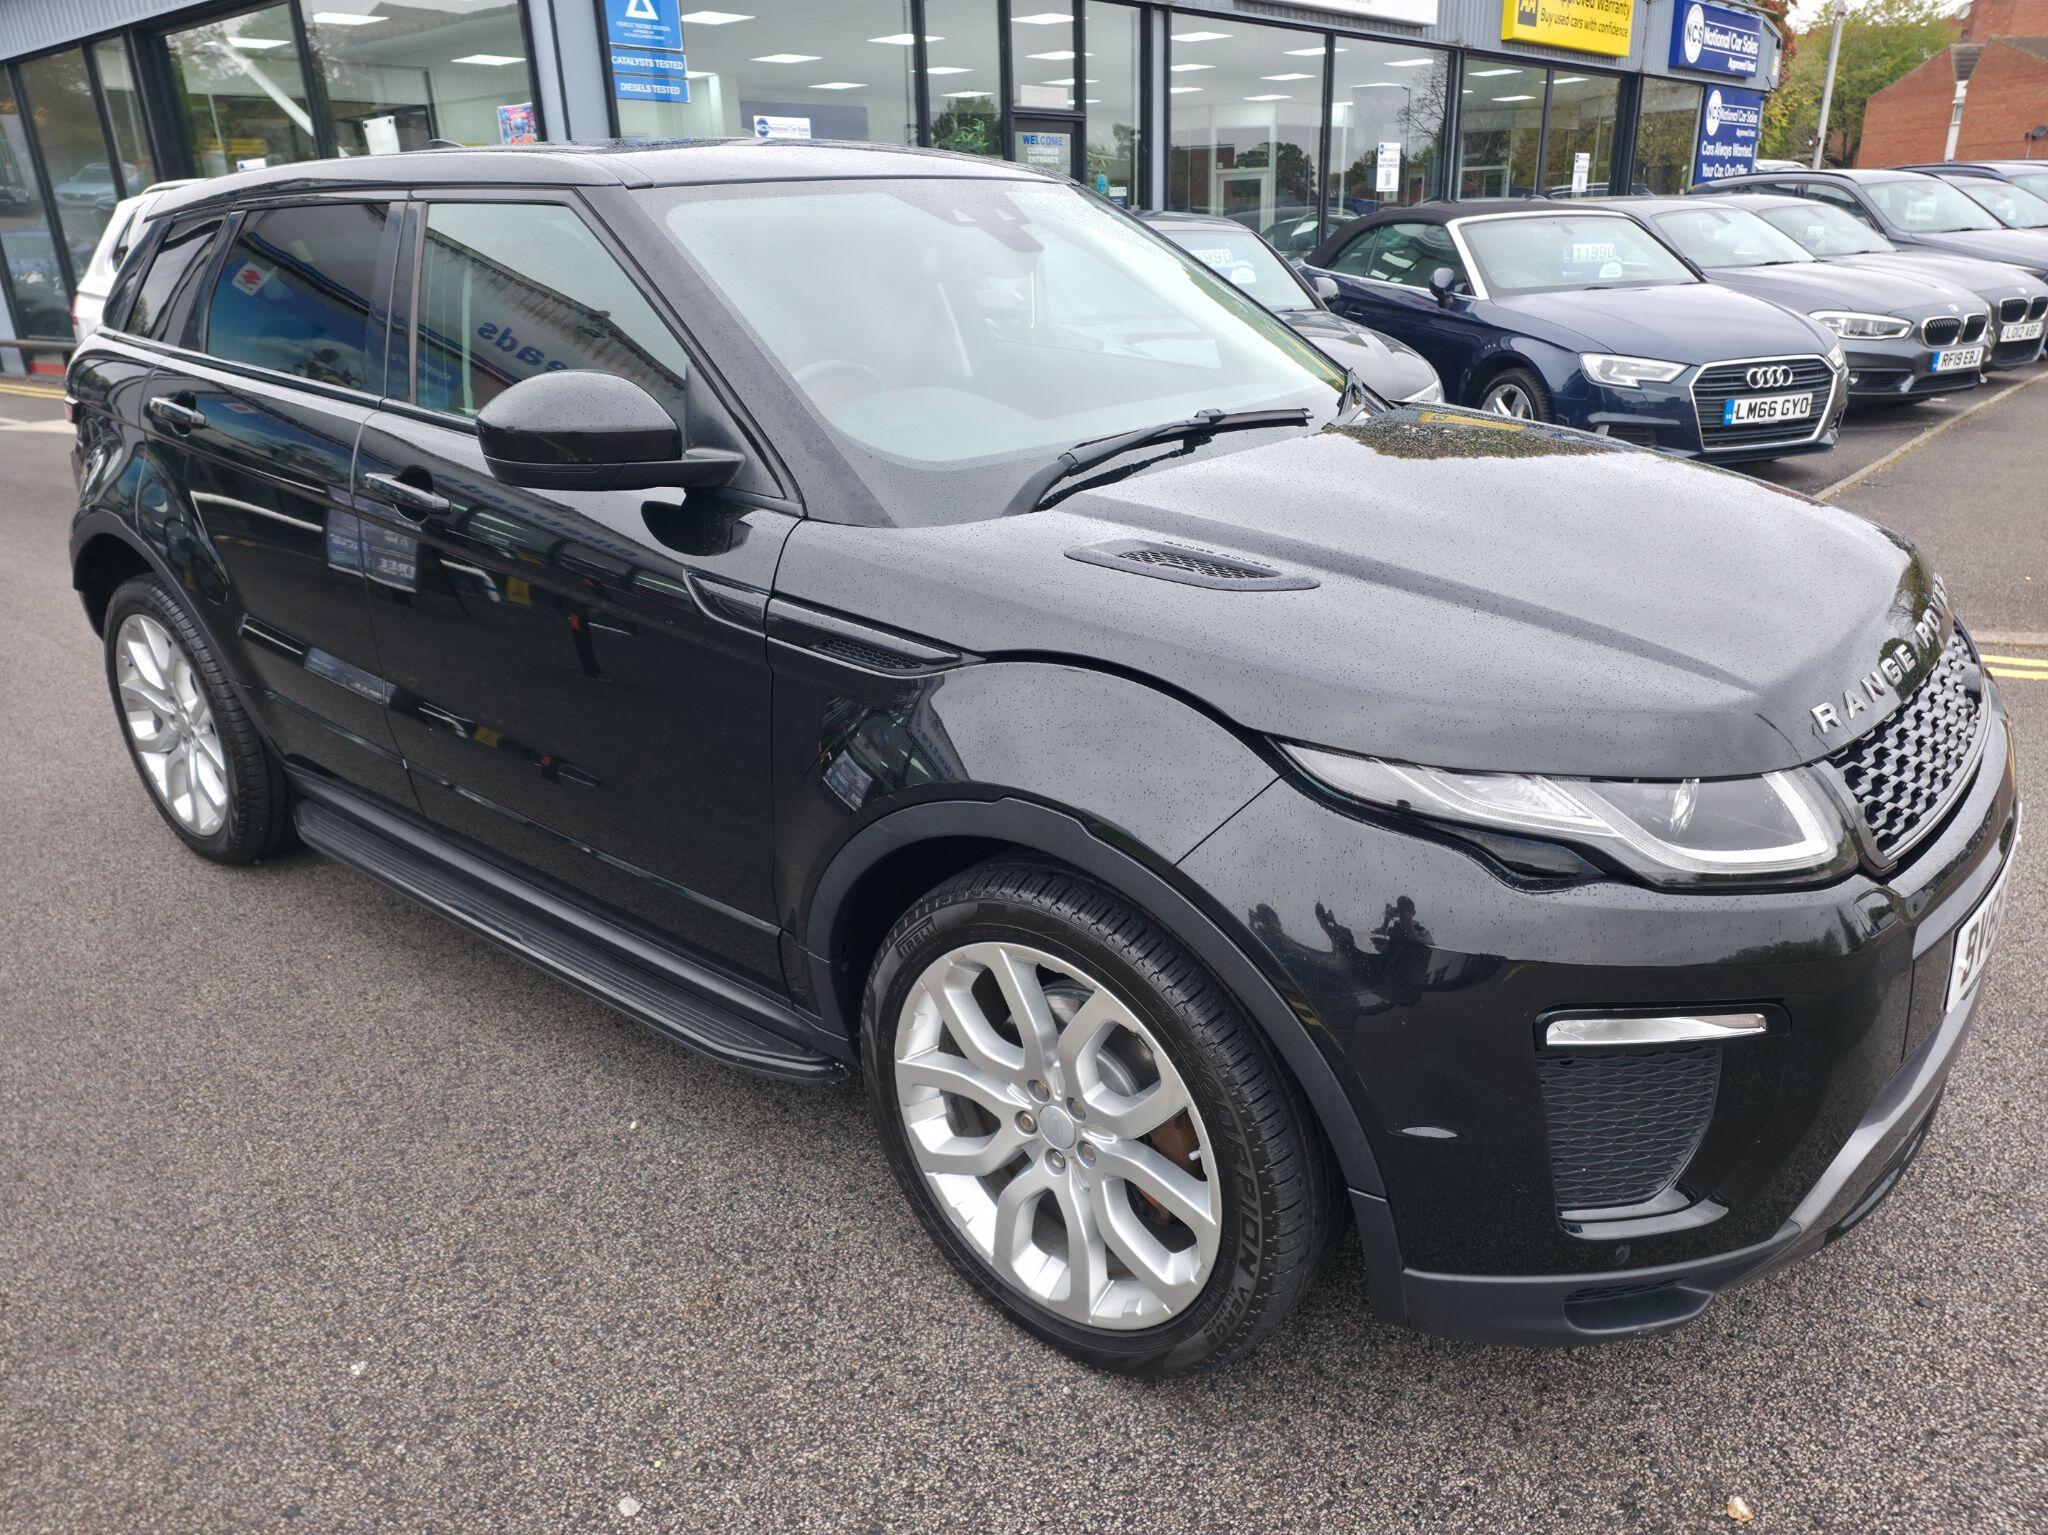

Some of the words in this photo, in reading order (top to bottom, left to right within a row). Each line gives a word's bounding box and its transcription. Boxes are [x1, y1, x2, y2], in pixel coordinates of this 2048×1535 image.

[1597, 0, 1631, 20] Warranty
[1540, 7, 1552, 27] Buy
[1554, 12, 1570, 26] used
[1570, 18, 1583, 29] cars
[1584, 17, 1597, 32] with
[1597, 21, 1628, 38] confidence
[1686, 23, 1703, 44] NCS
[1704, 26, 1731, 49] National
[1731, 33, 1742, 51] Car
[1742, 35, 1758, 55] Sales
[611, 56, 654, 67] CATALYSTS
[655, 59, 684, 70] TESTED
[1728, 57, 1745, 71] Approved
[620, 82, 652, 93] DIESELS
[652, 84, 680, 95] TESTED
[1720, 107, 1738, 122] National
[1738, 109, 1746, 122] Car
[1746, 110, 1758, 124] Sales
[1023, 135, 1063, 146] WELCOME
[1027, 146, 1059, 155] CUSTOMER
[1701, 140, 1715, 156] Cars
[1715, 141, 1732, 160] Always
[1027, 155, 1059, 164] ENTRANCE
[1701, 162, 1714, 178] Your
[1724, 163, 1734, 177] Our
[1576, 246, 1615, 260] 11990
[1941, 352, 1962, 367] RF19
[1963, 350, 1980, 366] EBJ
[1736, 401, 1778, 420] LM66
[1781, 397, 1809, 416] GYO
[1810, 644, 1916, 734] RANGE
[1915, 572, 1948, 650] ROVER
[895, 917, 938, 958] PIRELLI
[1183, 1038, 1261, 1279] SCORPION
[1205, 1285, 1250, 1346] VERDE
